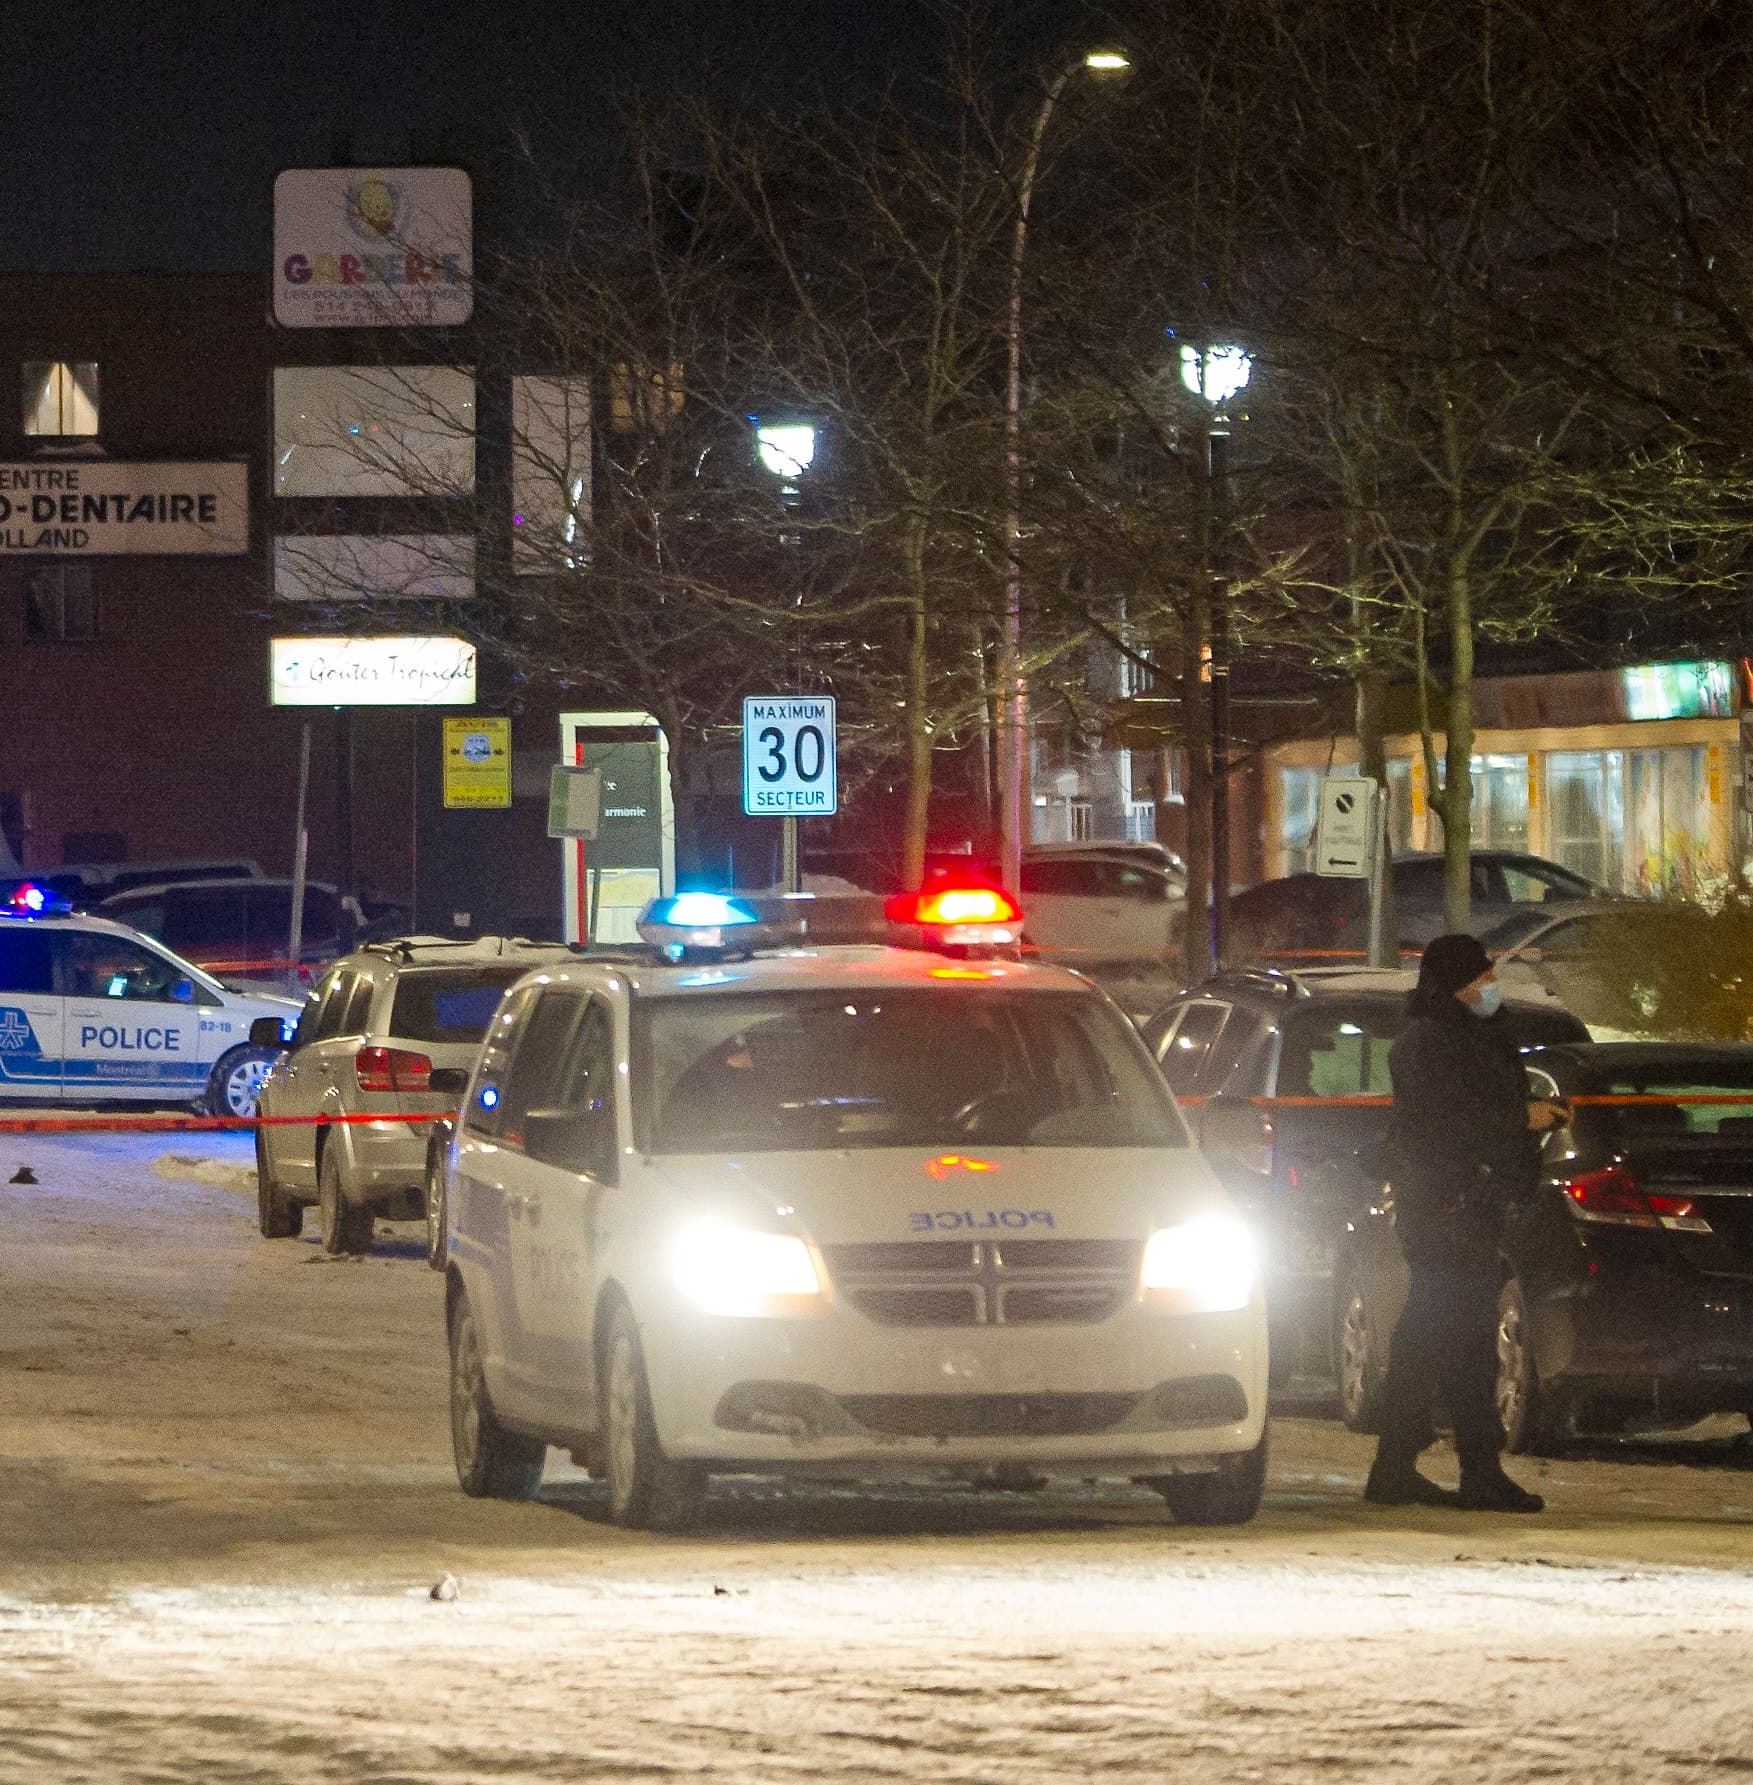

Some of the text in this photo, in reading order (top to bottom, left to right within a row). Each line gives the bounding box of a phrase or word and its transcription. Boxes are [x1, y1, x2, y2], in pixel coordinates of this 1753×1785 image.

[753, 704, 826, 719] MAXIMUM
[757, 724, 826, 783] 30
[756, 791, 825, 806] SECTEUR
[200, 1020, 232, 1033] 82-18
[80, 1026, 181, 1051] POLICE
